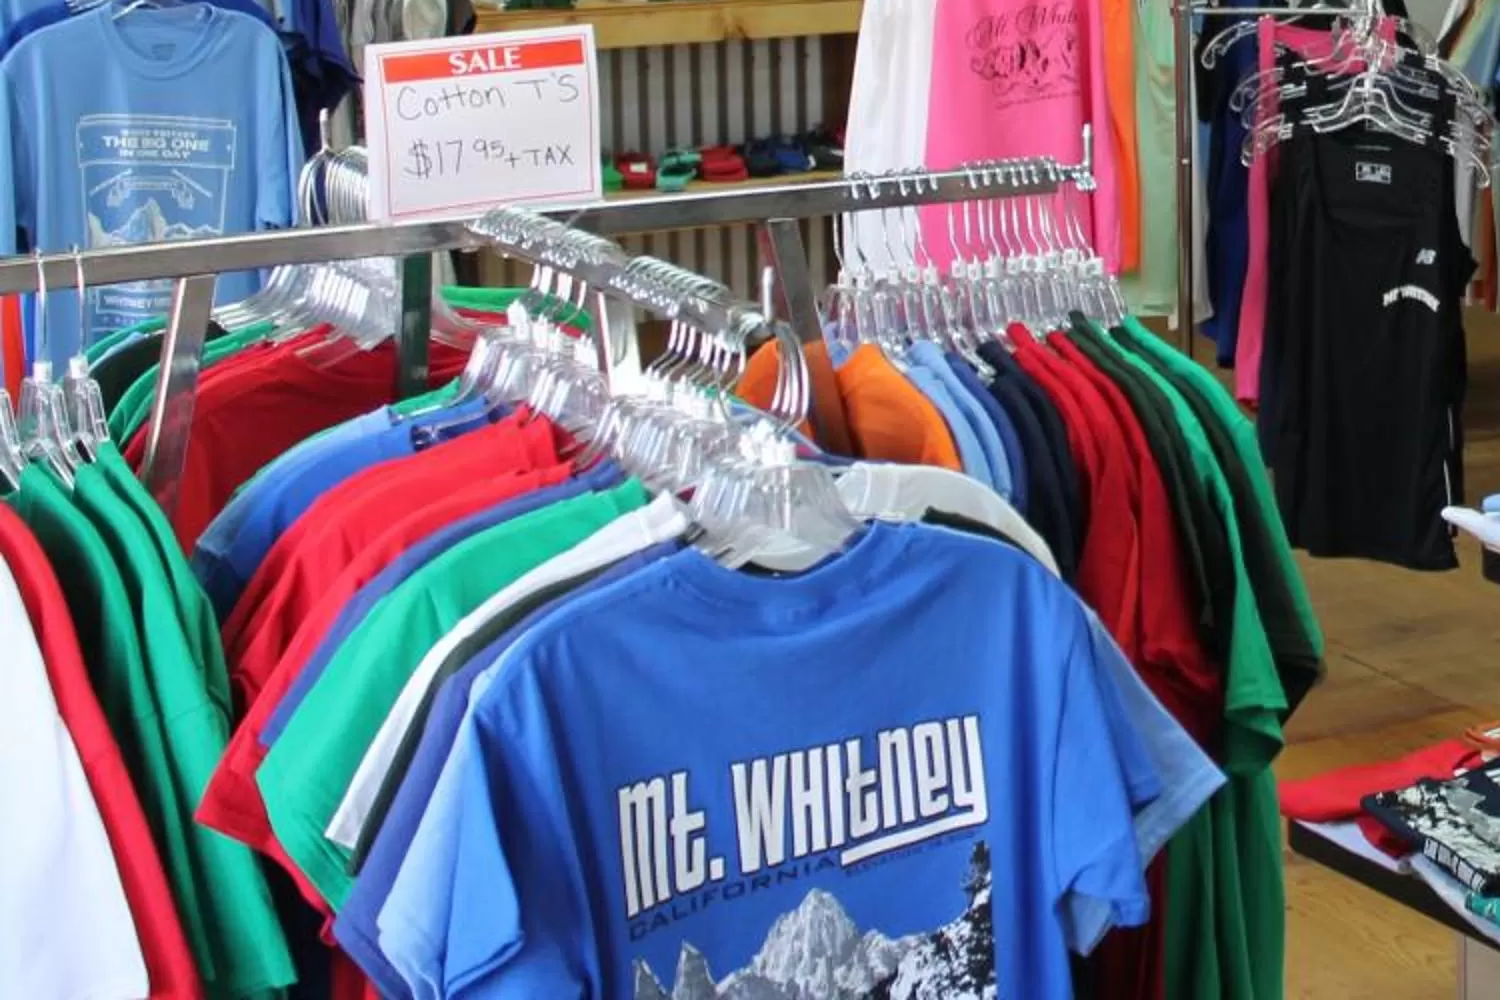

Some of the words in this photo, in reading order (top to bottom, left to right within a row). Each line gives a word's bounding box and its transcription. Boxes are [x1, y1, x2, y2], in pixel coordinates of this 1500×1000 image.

[449, 47, 522, 74] SALE
[397, 83, 506, 121] Cotton
[102, 135, 139, 149] THE
[171, 138, 209, 151] ONE
[628, 855, 838, 943] CALIFORNIA
